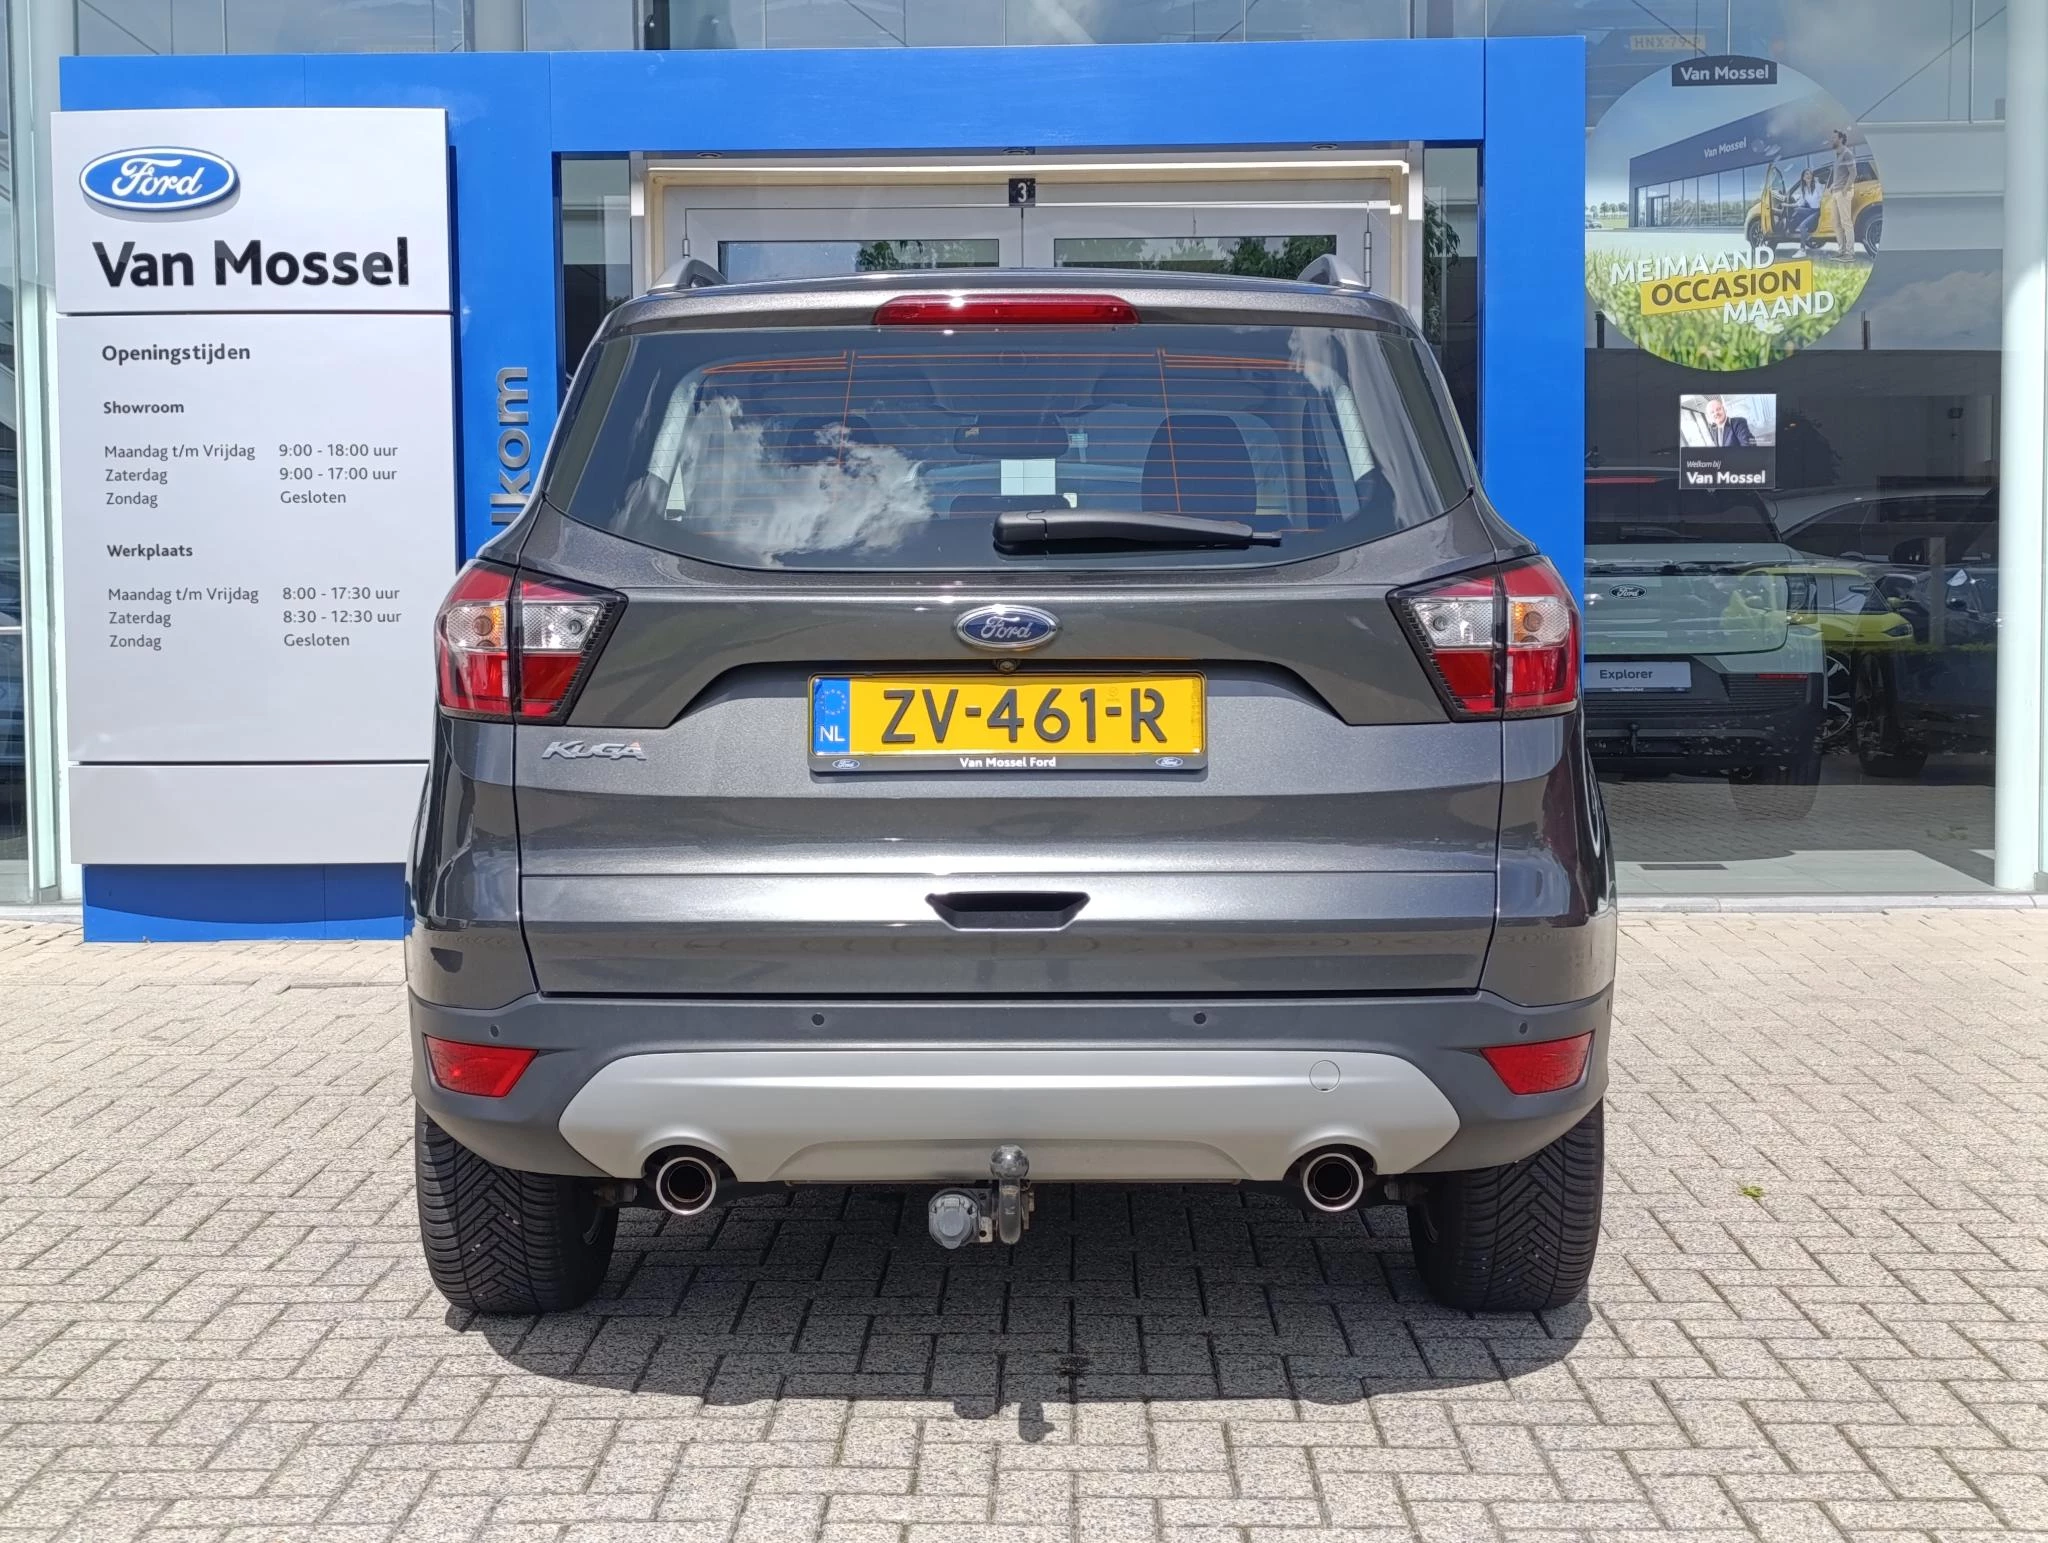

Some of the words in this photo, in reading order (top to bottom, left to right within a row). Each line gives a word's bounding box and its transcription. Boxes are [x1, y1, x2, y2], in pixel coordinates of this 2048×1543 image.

[1680, 66, 1710, 81] Van
[1714, 64, 1770, 80] Mossel
[1703, 147, 1718, 159] Van
[1718, 136, 1748, 154] Mossel
[111, 157, 205, 197] Ford
[1017, 182, 1027, 203] 3
[91, 241, 195, 288] Van
[214, 236, 410, 287] Mossel
[1611, 246, 1775, 285] MEIMAAND
[1651, 268, 1801, 306] OCCASION
[1723, 290, 1835, 325] MAAND
[101, 342, 251, 367] Openingstijden
[103, 400, 185, 415] Showroom
[104, 444, 169, 462] Maandag
[172, 443, 199, 458] t/m
[202, 443, 256, 461] Vrijdag
[279, 443, 313, 457] 9:00
[327, 443, 369, 457] 18:00
[373, 447, 399, 457] uur
[104, 467, 168, 485] Zaterdag
[279, 467, 313, 481] 9:00
[327, 467, 369, 481] 17:00
[372, 470, 398, 481] uur
[1686, 471, 1713, 484] Van
[1717, 469, 1766, 484] Mossel
[105, 491, 159, 509] Zondag
[280, 489, 347, 504] Gesloten
[106, 543, 193, 561] Werkplaats
[108, 587, 173, 605] Maandag
[175, 587, 203, 601] t/m
[206, 586, 259, 605] Vrijdag
[282, 586, 317, 600] 8:00
[330, 586, 371, 600] 17:30
[375, 589, 401, 600] uur
[108, 610, 172, 628] Zaterdag
[282, 610, 317, 624] 8:30
[331, 609, 373, 623] 12:30
[377, 612, 402, 623] uur
[980, 615, 1032, 639] Ford
[109, 633, 162, 652] Zondag
[283, 632, 350, 647] Gesloten
[1599, 669, 1653, 681] Explorer
[881, 687, 1169, 744] ZV-461-R
[819, 725, 846, 742] NL
[959, 757, 983, 768] Van
[985, 756, 1027, 768] Mossel
[1029, 756, 1057, 768] Ford
